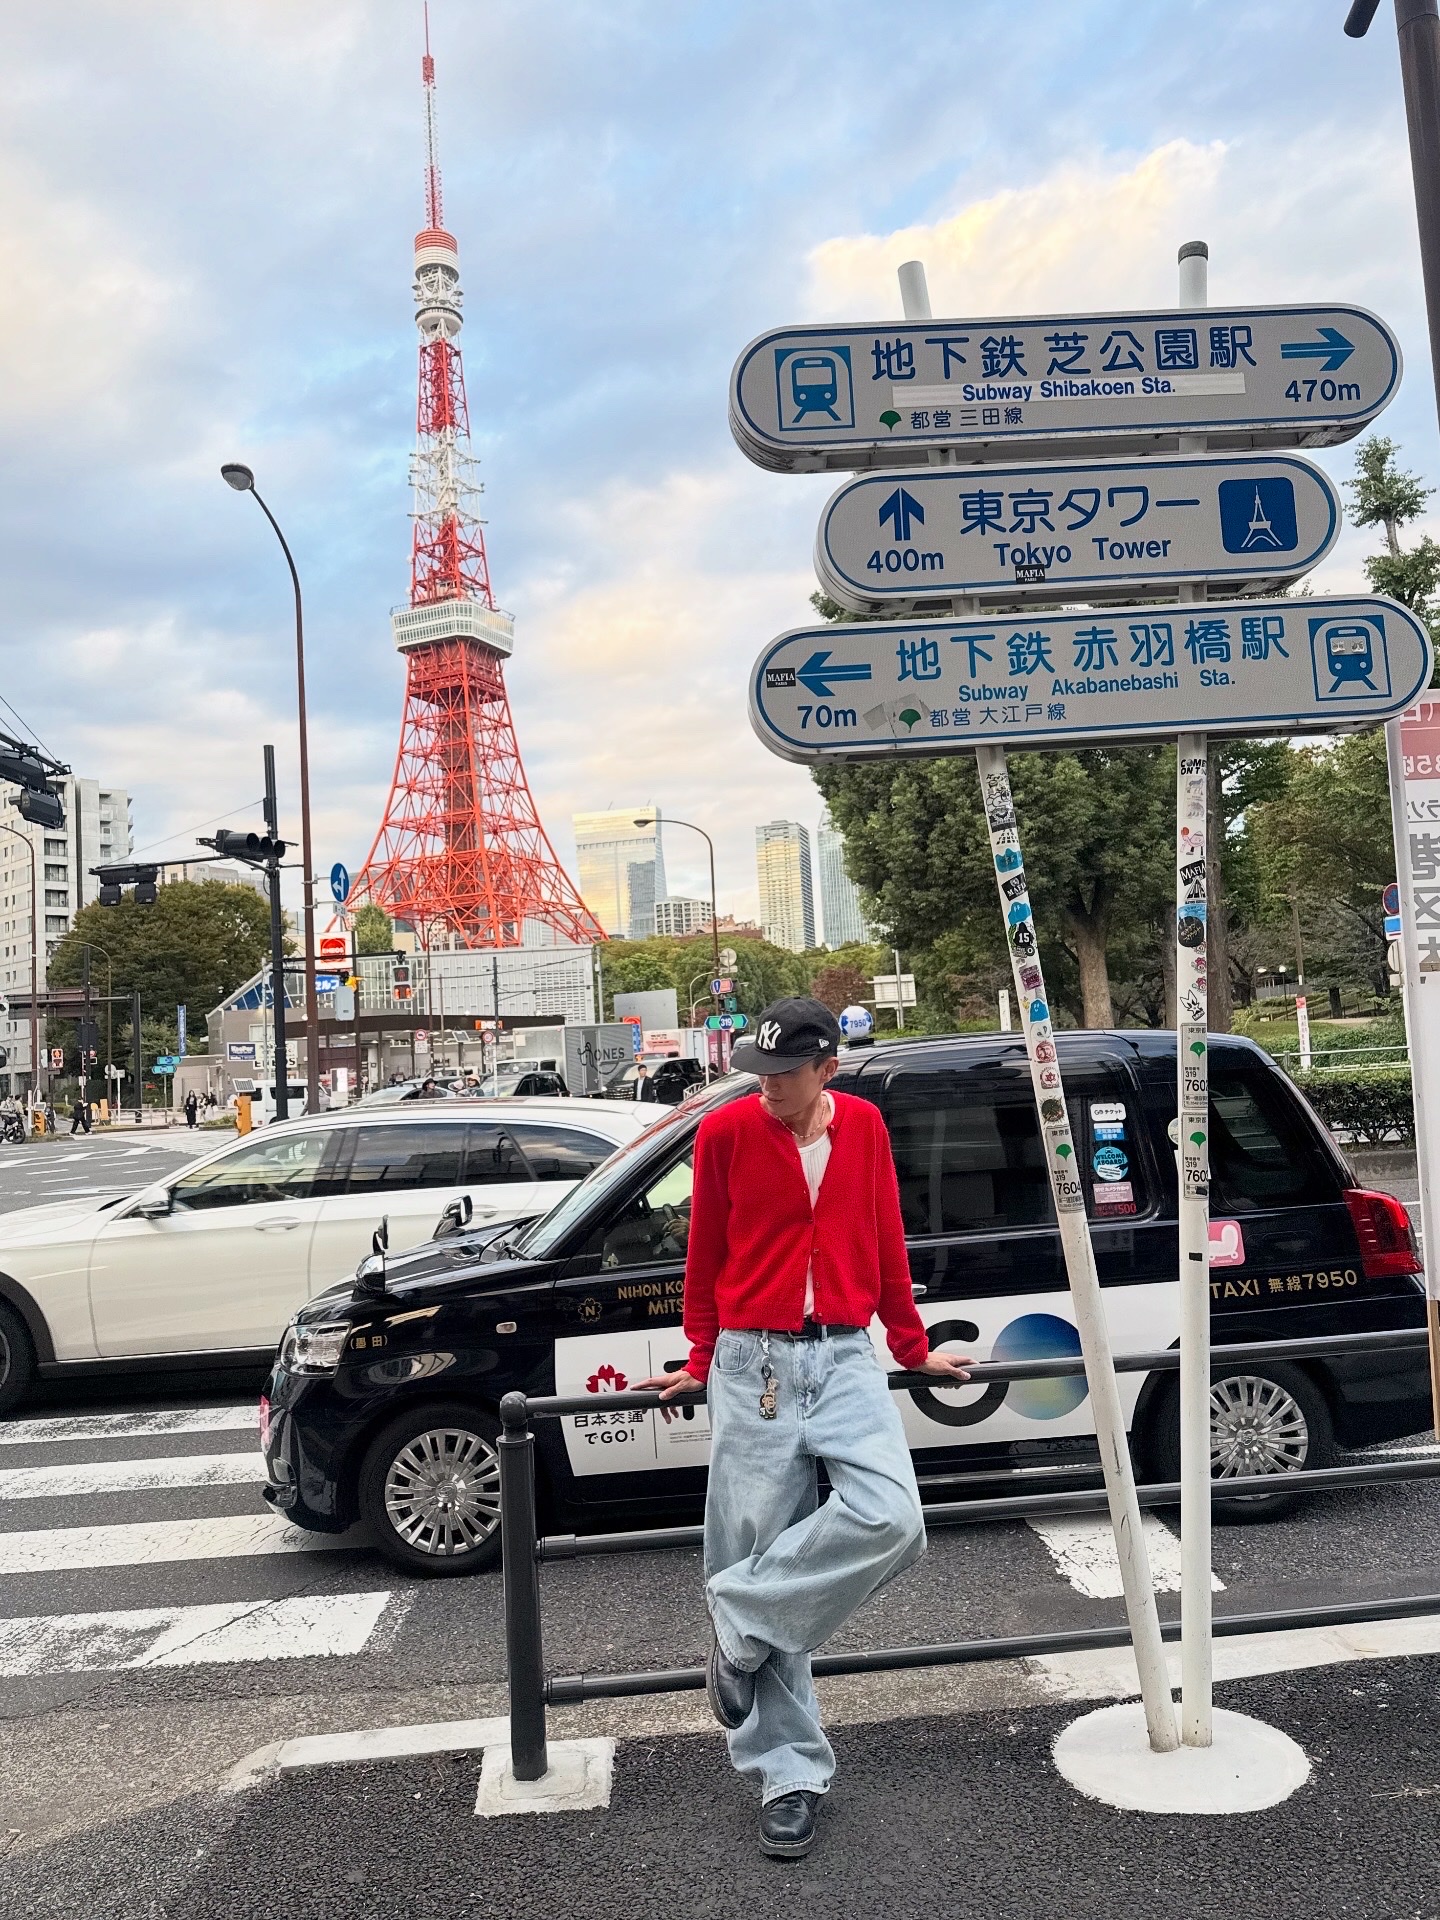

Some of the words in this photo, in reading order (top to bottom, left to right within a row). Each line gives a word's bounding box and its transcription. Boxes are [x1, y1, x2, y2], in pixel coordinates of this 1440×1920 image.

[871, 335, 1028, 380] 地下鉄
[1044, 325, 1257, 375] 芝公園駅
[962, 383, 1032, 403] Subway
[1040, 379, 1135, 398] Shibakoen
[1142, 377, 1176, 395] Sta.
[1284, 379, 1361, 404] 470m
[910, 409, 951, 429] 都営
[960, 407, 1024, 426] 三田線
[959, 485, 1200, 536] 東京タワー
[866, 549, 944, 573] 400m
[993, 542, 1072, 569] Tokyo
[1092, 537, 1171, 561] Tower
[1016, 569, 1044, 578] MAFIA
[896, 630, 1055, 682] 地下鉄
[1072, 616, 1289, 671] 赤羽橋駅
[767, 672, 795, 682] MAFIA
[958, 683, 1029, 703] Subway
[1051, 671, 1179, 696] Akabanebashi
[1199, 669, 1236, 687] Sta.
[797, 705, 857, 729] 70m
[929, 707, 970, 728] 都営
[979, 703, 1067, 724] 大江戸線
[1019, 932, 1029, 943] 15
[720, 1018, 732, 1026] 319
[850, 1020, 867, 1028] 7950
[618, 1283, 661, 1300] NIHON
[1210, 1279, 1260, 1299] TAXI
[574, 1410, 644, 1428] 日本交通
[585, 1429, 635, 1445] でGO!
